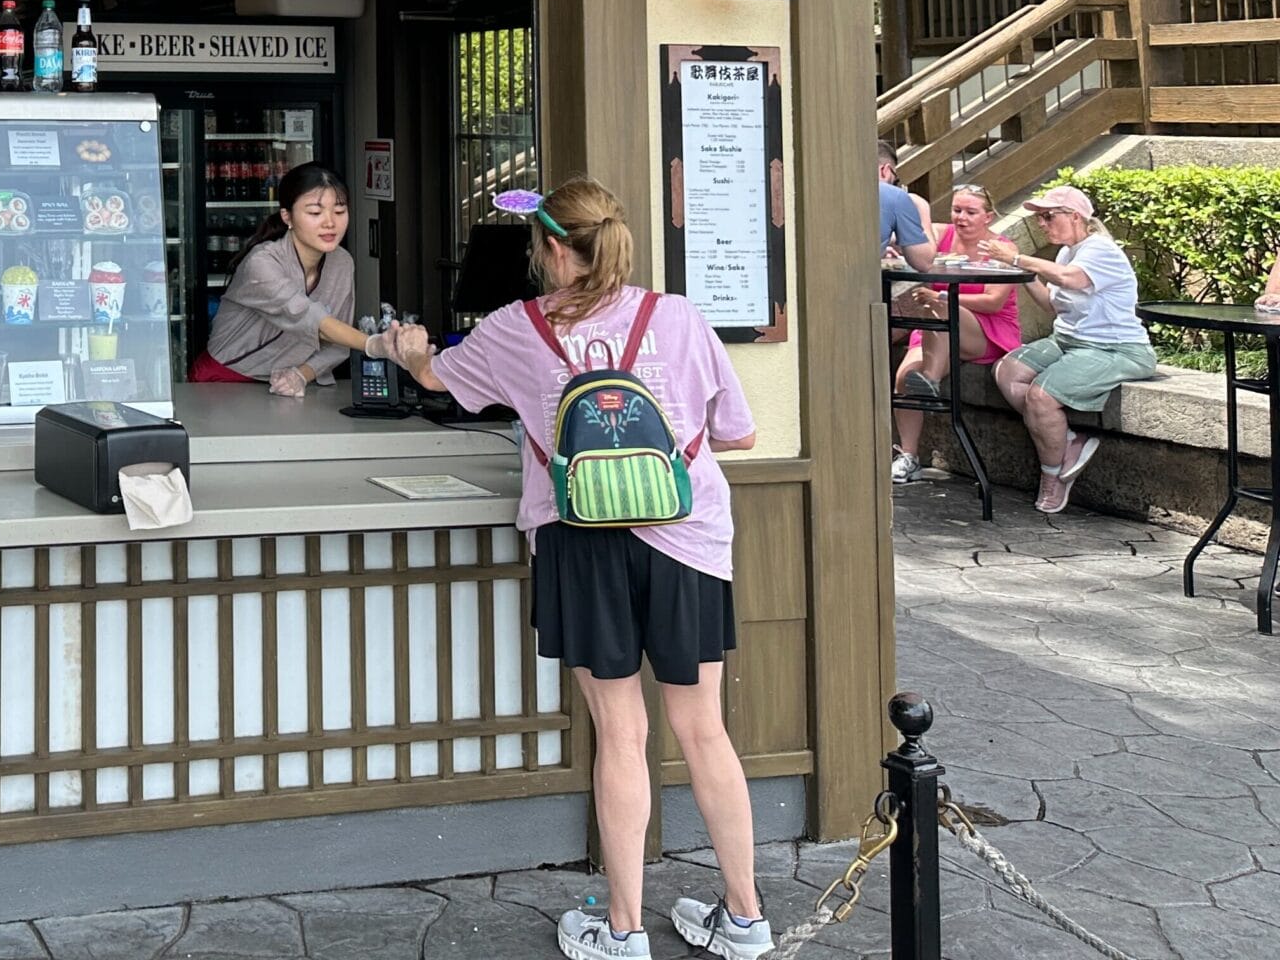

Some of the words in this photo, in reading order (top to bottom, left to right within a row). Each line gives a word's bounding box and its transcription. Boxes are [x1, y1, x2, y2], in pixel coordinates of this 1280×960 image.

[97, 34, 126, 56] KE
[140, 34, 195, 58] BEER
[209, 35, 288, 59] SHAVED
[295, 36, 327, 59] ICE
[690, 65, 760, 82] 歌舞伎茶屋
[707, 93, 736, 102] Kakigori
[579, 322, 609, 340] The
